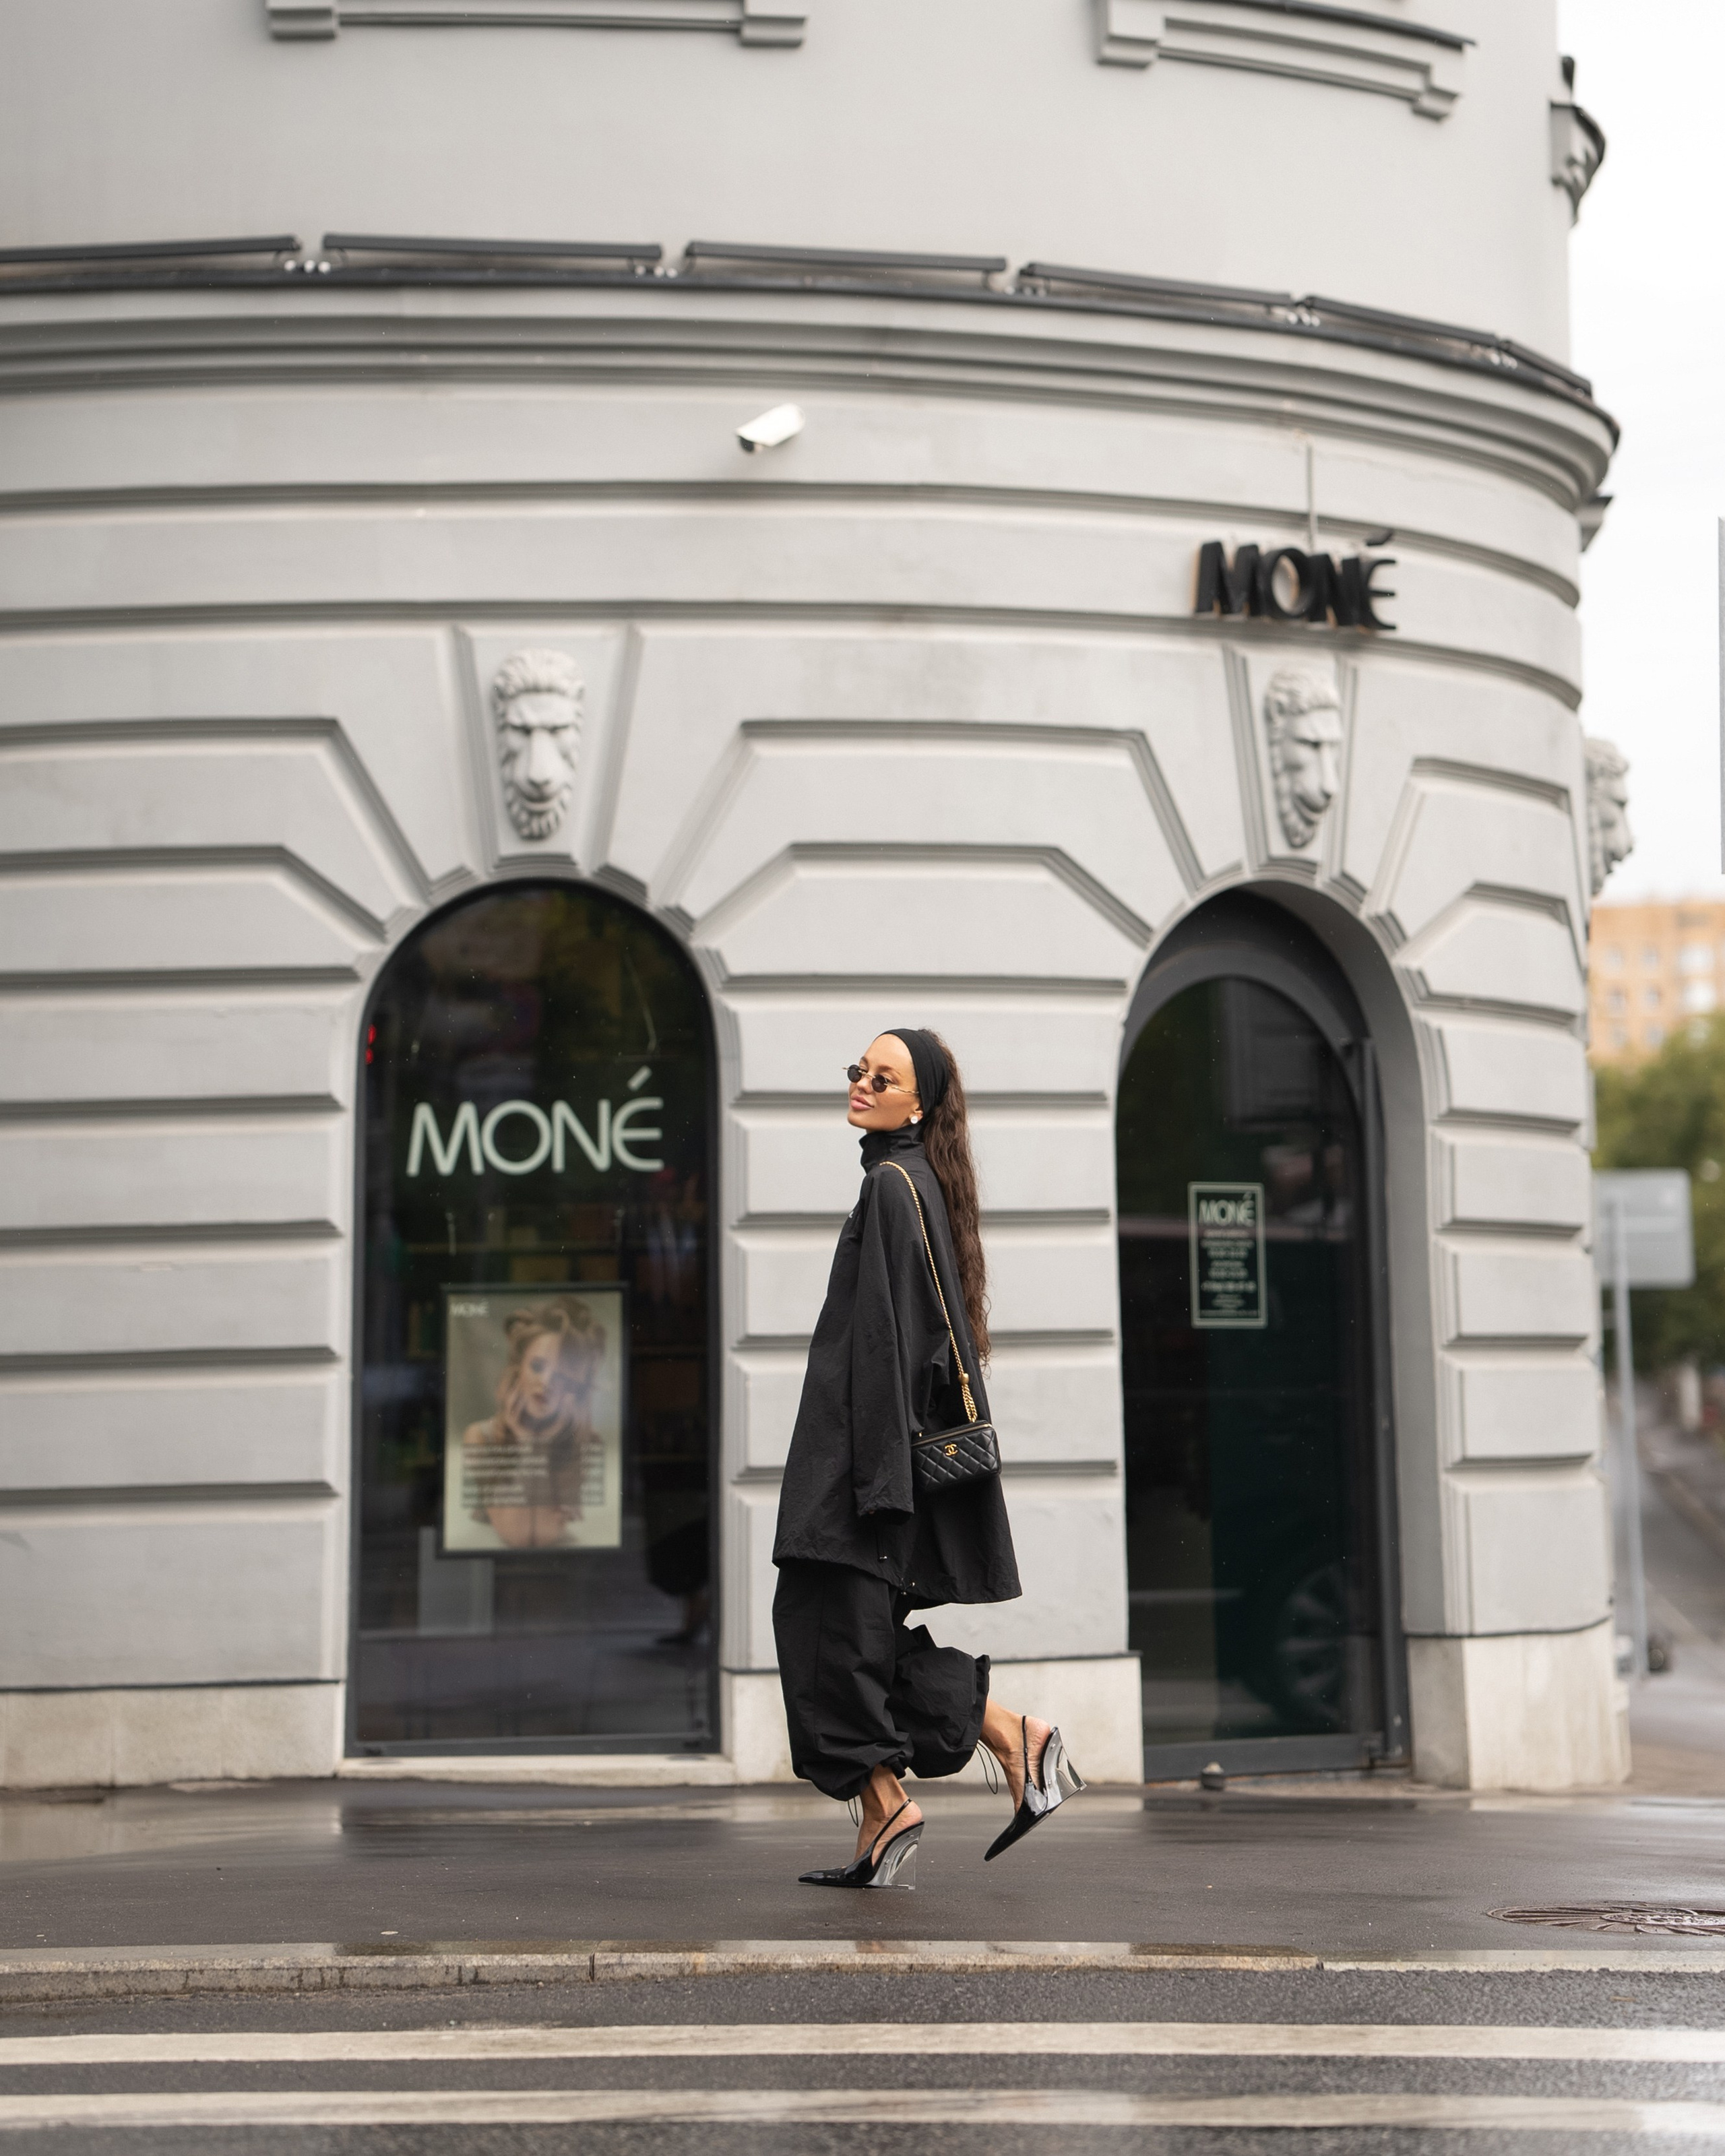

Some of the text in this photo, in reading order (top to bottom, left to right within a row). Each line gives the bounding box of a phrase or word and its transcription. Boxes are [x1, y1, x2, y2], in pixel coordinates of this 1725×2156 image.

[1194, 529, 1397, 629] MONÉ
[406, 1065, 664, 1177] MONÉ
[1199, 1191, 1255, 1226] MONÉ
